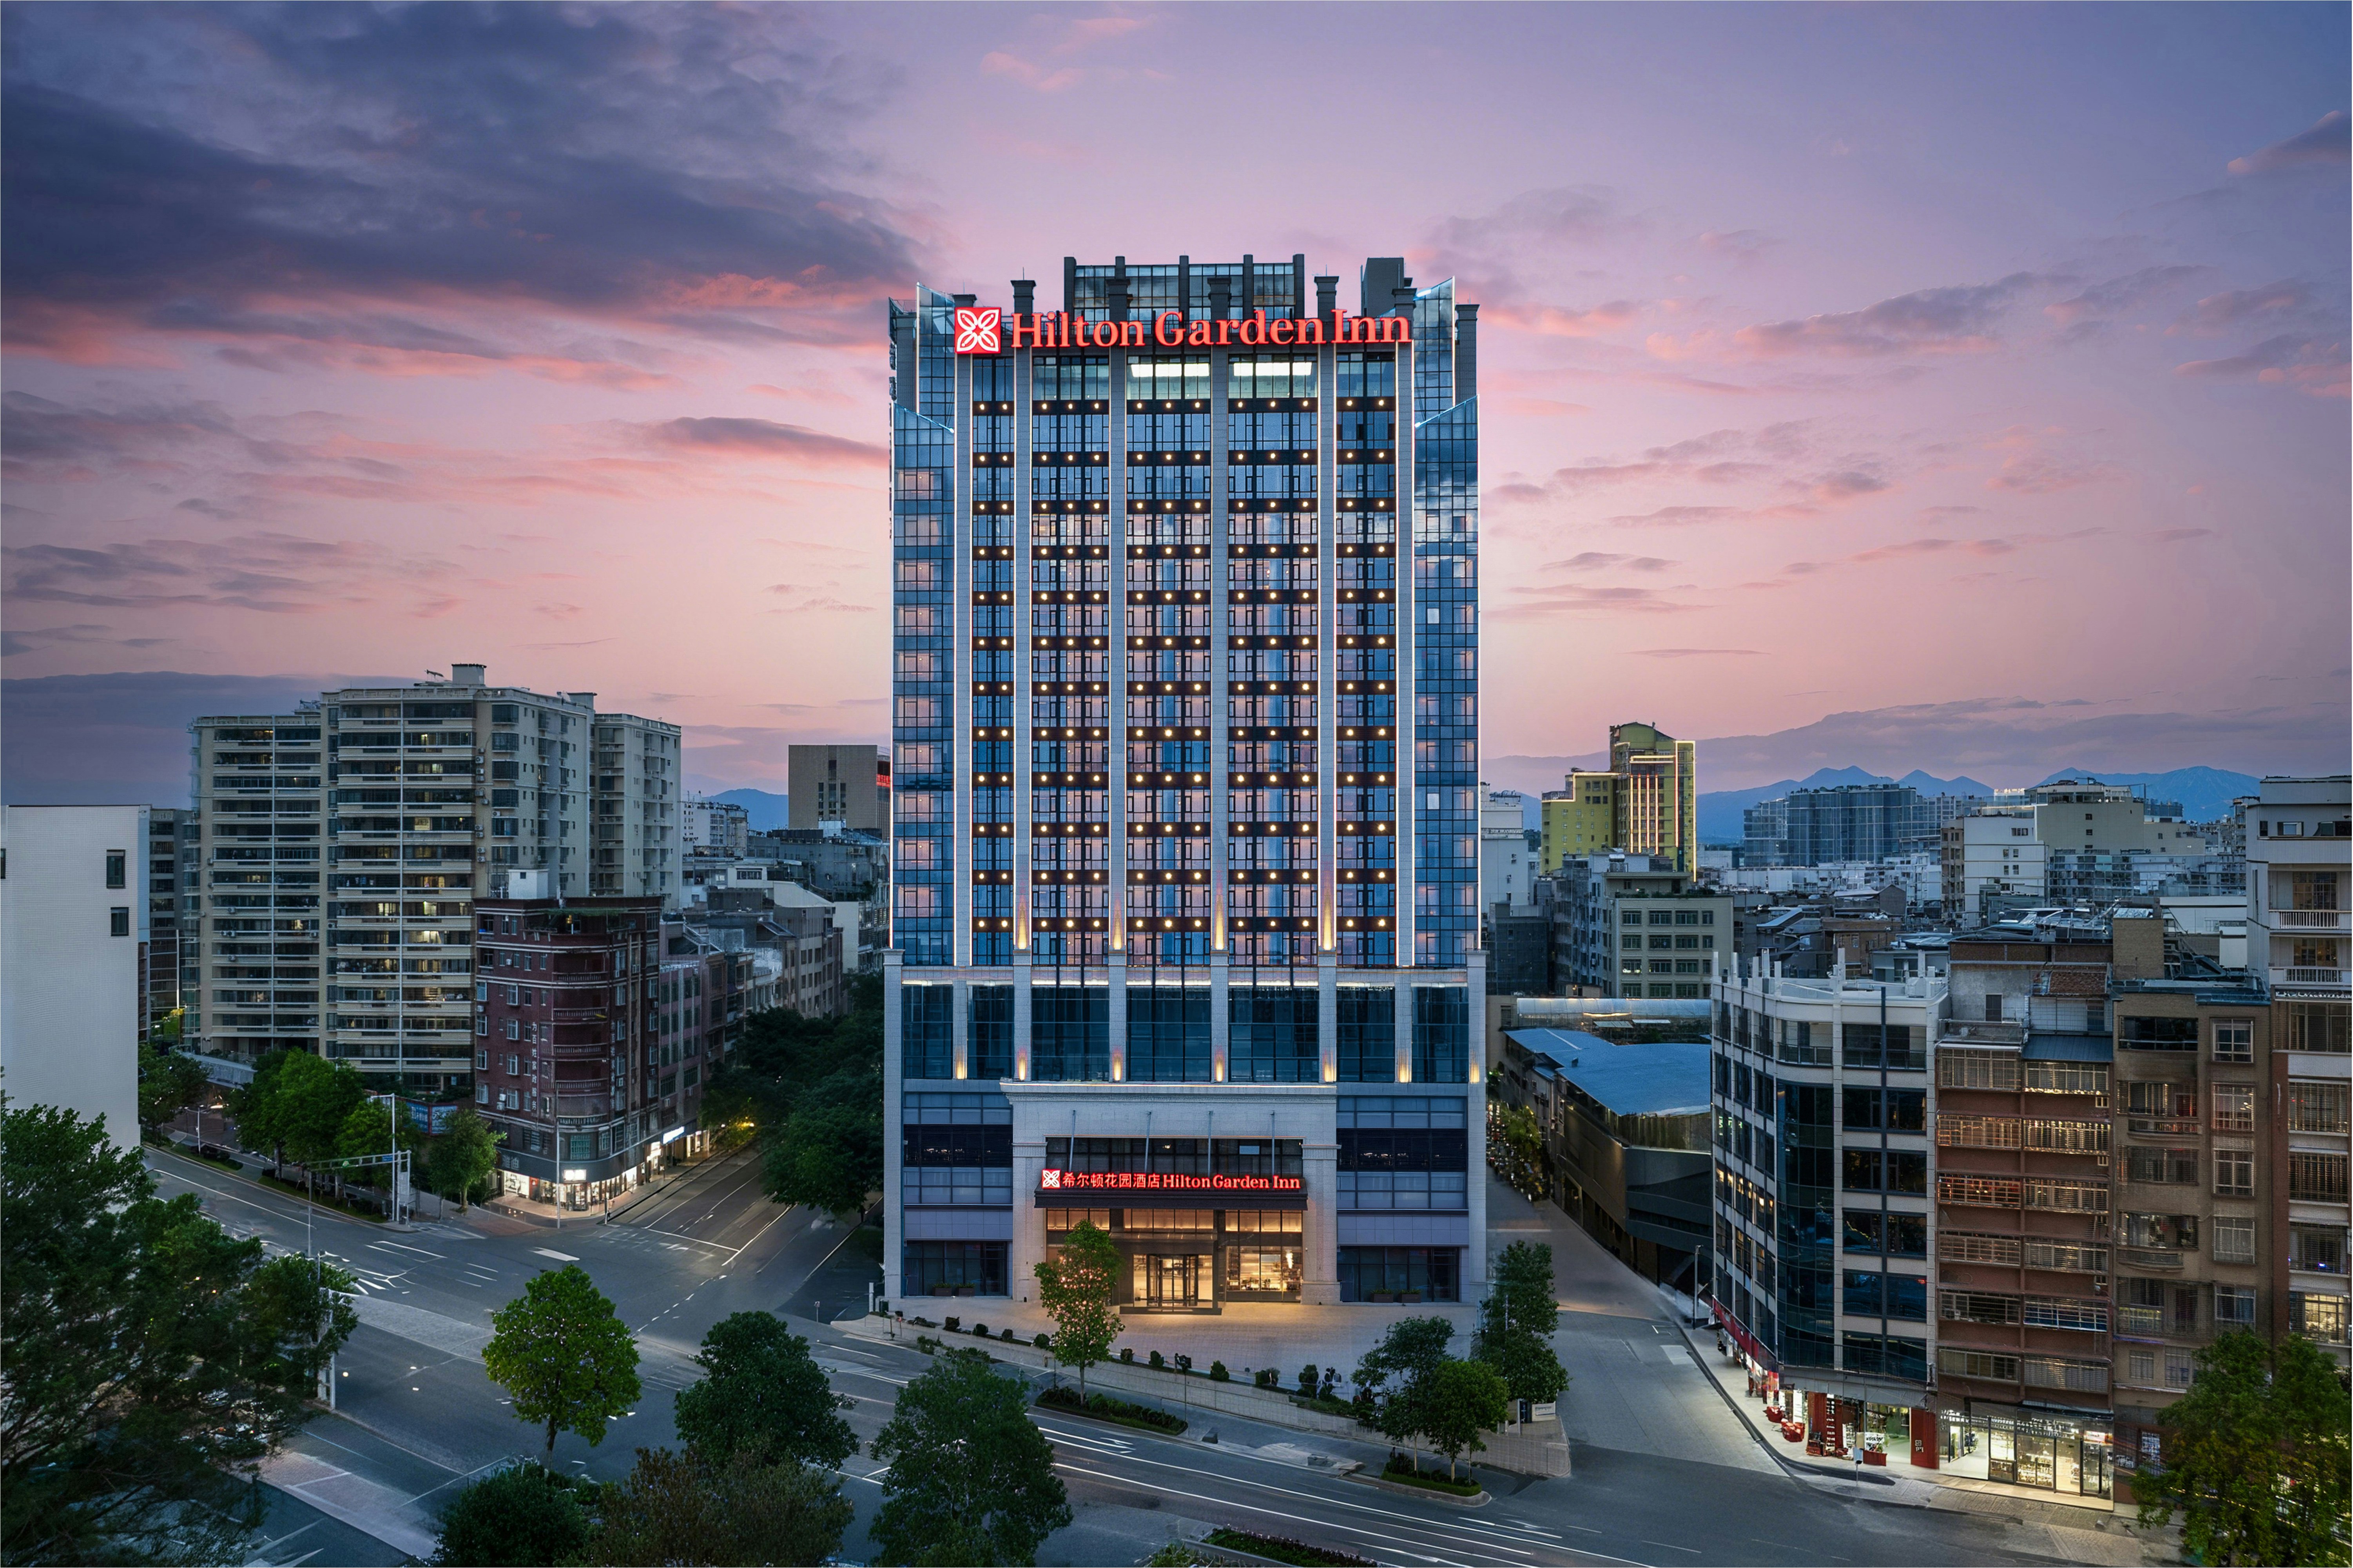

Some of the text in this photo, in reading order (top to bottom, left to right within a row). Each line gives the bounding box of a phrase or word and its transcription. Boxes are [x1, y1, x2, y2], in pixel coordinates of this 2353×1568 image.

[1011, 309, 1412, 347] Hilton Garden Inn
[1062, 1172, 1300, 1188] 希尔顿花园酒店 Hilton Garden Inn
